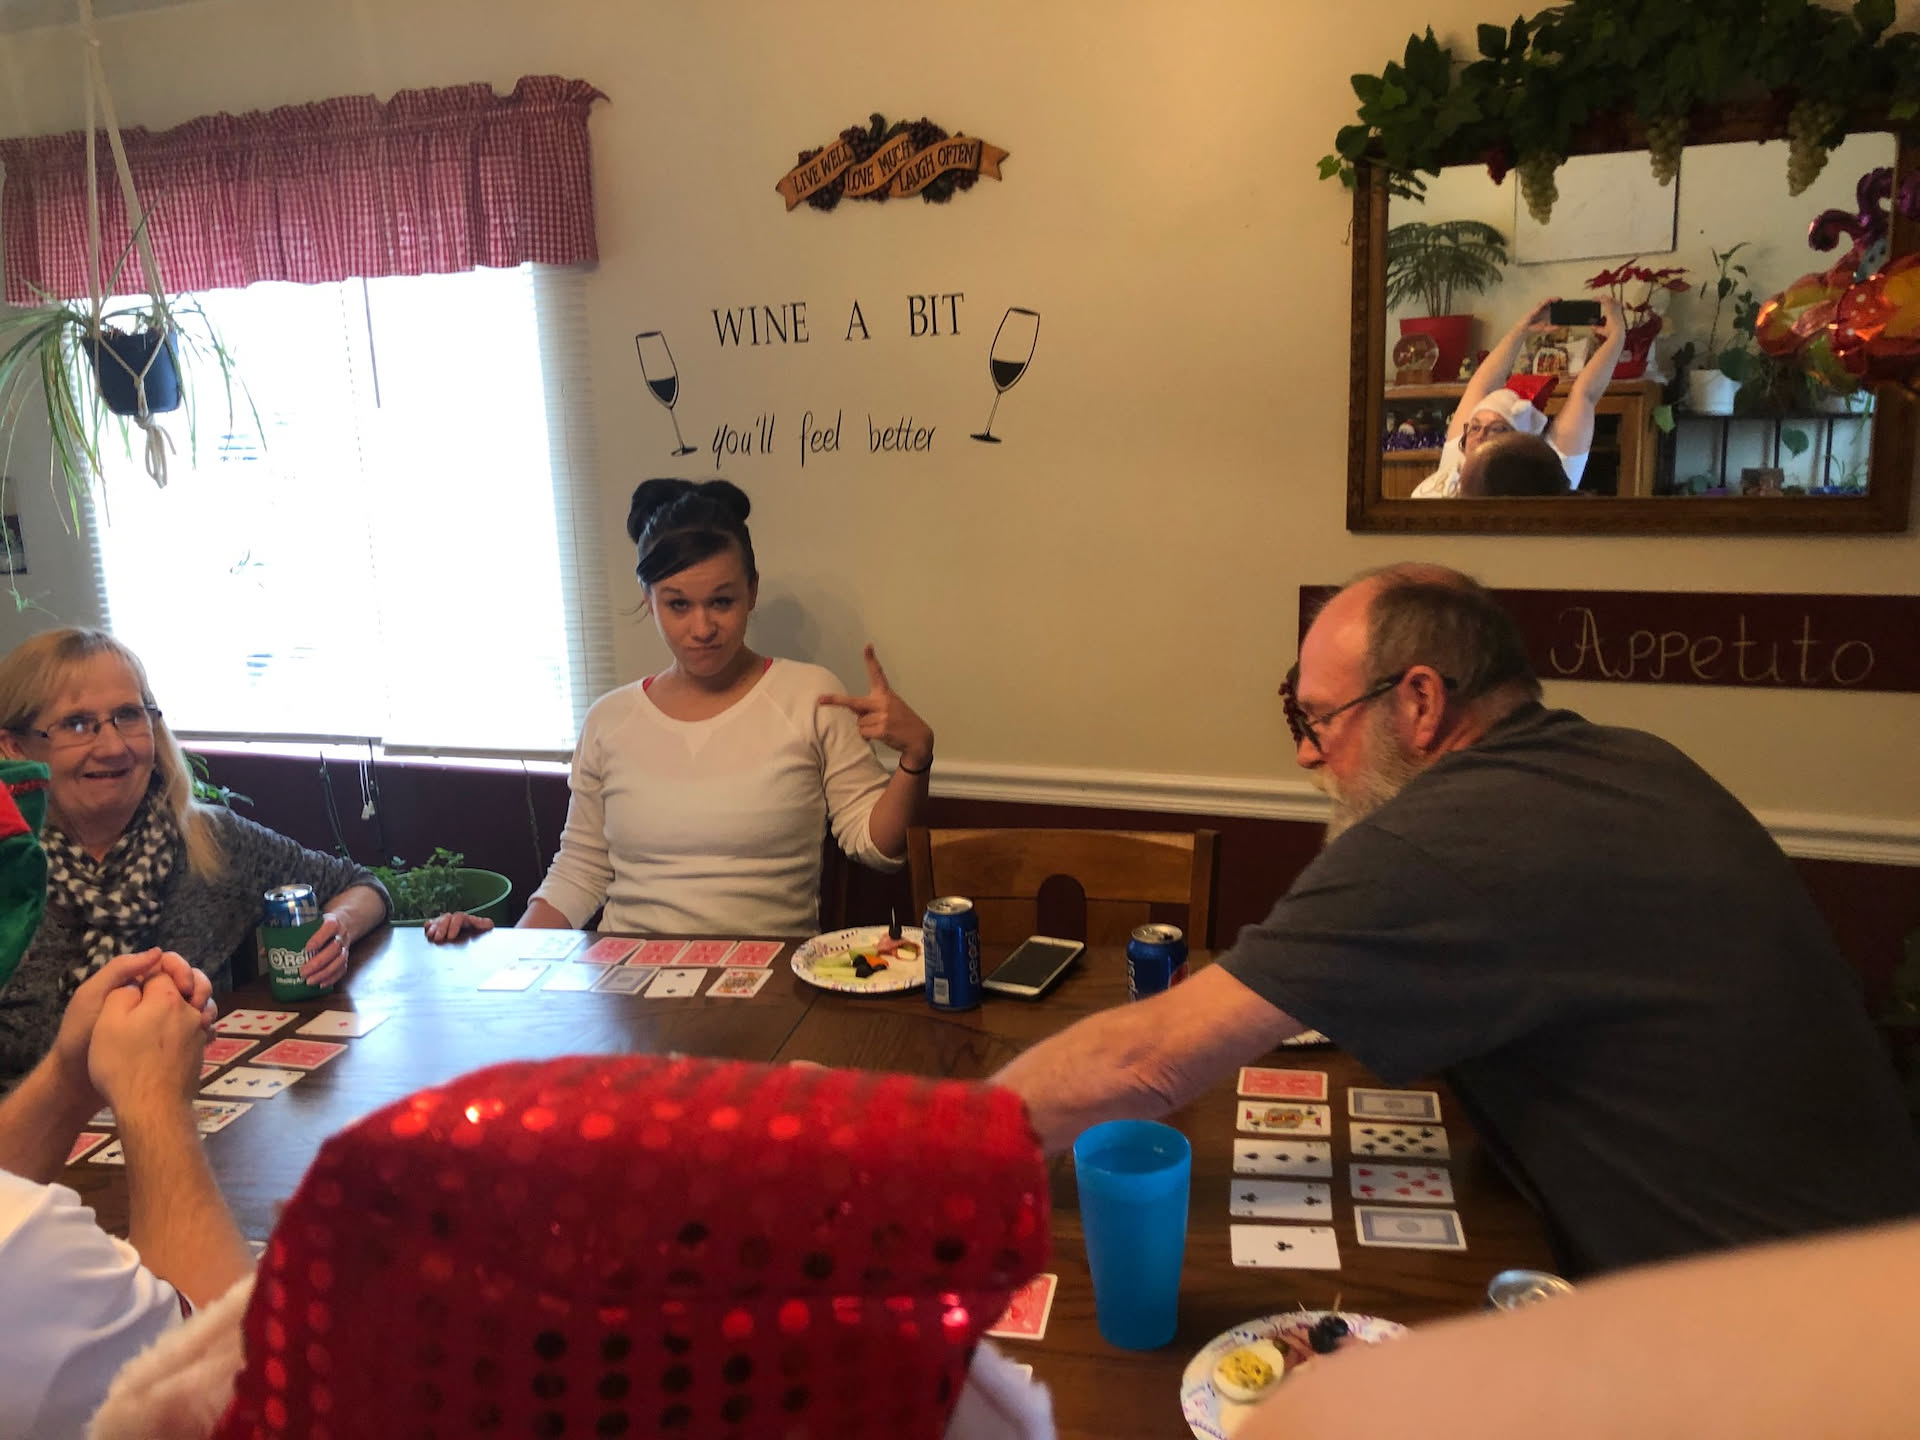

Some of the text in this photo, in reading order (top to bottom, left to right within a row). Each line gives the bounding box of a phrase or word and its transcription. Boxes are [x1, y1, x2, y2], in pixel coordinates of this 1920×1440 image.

[793, 143, 849, 194] LIVE WELL
[847, 140, 911, 192] LOVE MUCH
[898, 143, 975, 192] LAUGH OFTEN
[711, 292, 964, 347] WINE A BIT
[712, 408, 936, 470] you'll feel better
